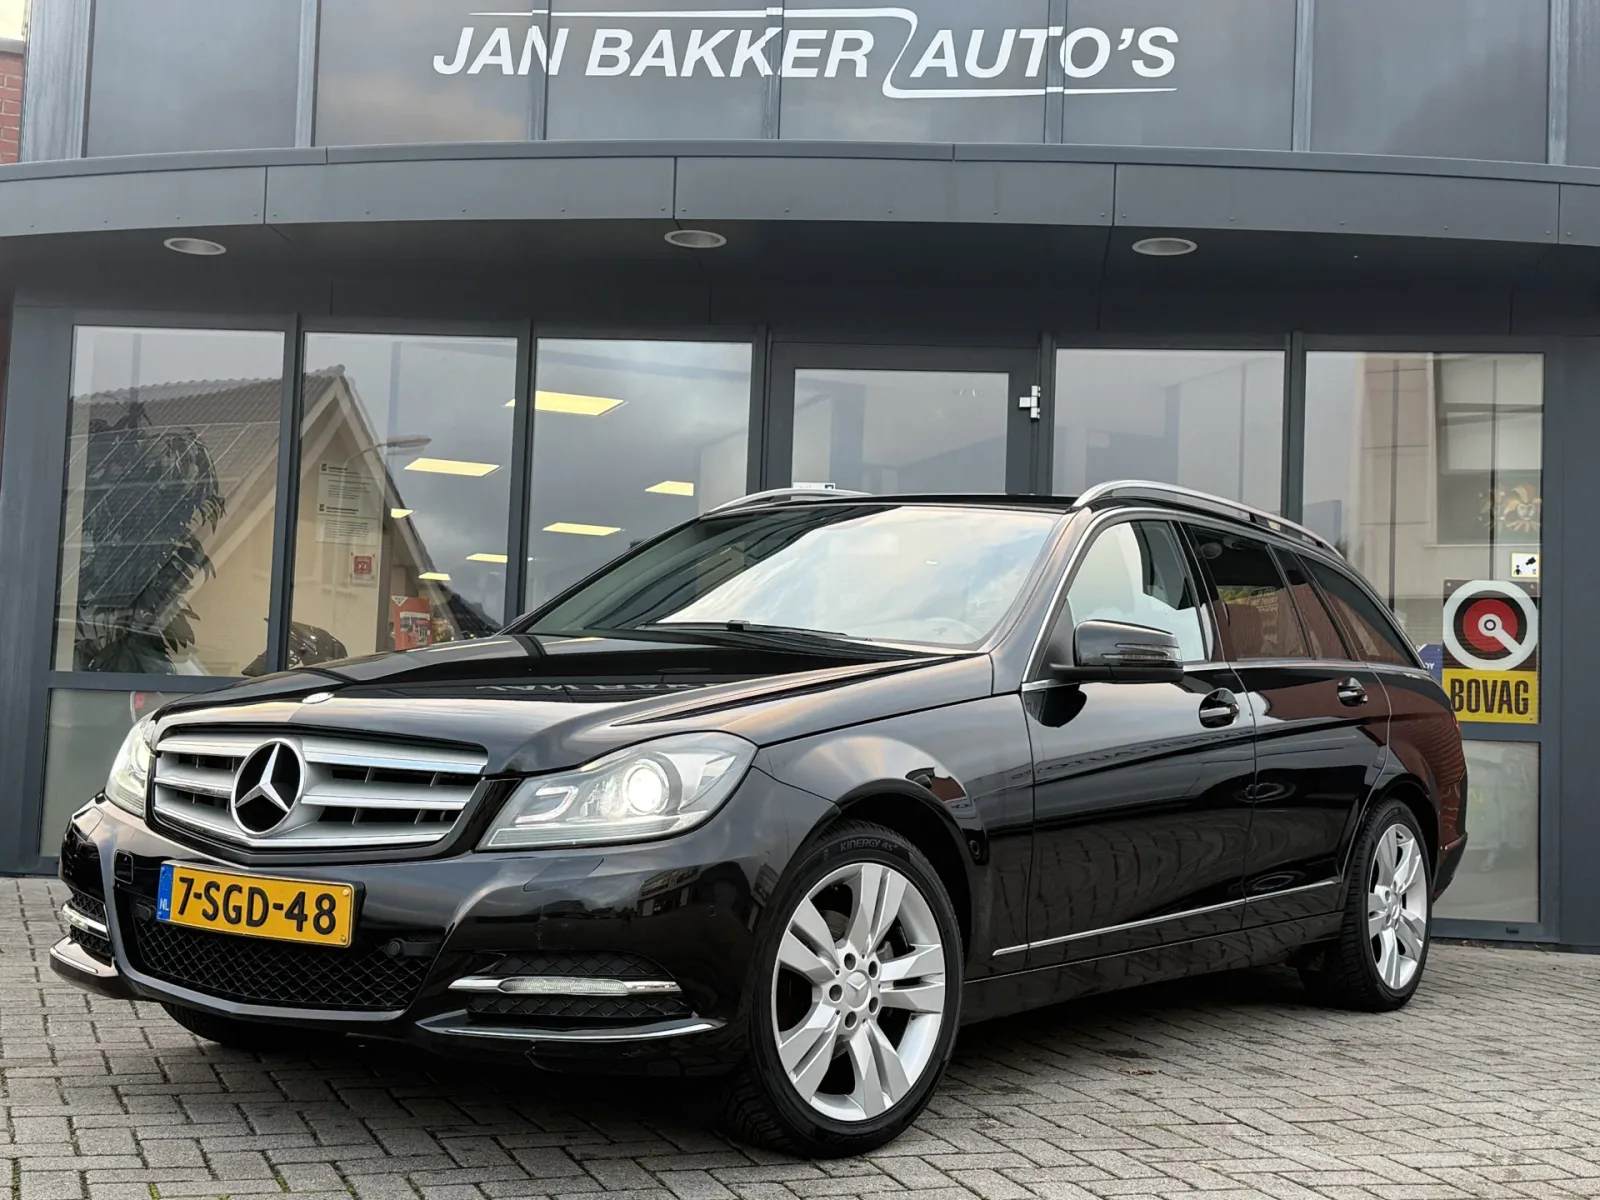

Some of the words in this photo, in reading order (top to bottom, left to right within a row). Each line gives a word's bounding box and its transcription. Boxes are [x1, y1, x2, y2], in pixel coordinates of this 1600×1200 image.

[433, 26, 569, 76] JAN
[585, 27, 874, 78] BAKKER
[909, 26, 1179, 78] AUTO'S
[1450, 678, 1529, 716] BOVAG
[841, 838, 880, 852] KINERGY
[159, 897, 170, 911] NL
[177, 876, 337, 936] 7-SGD-48
